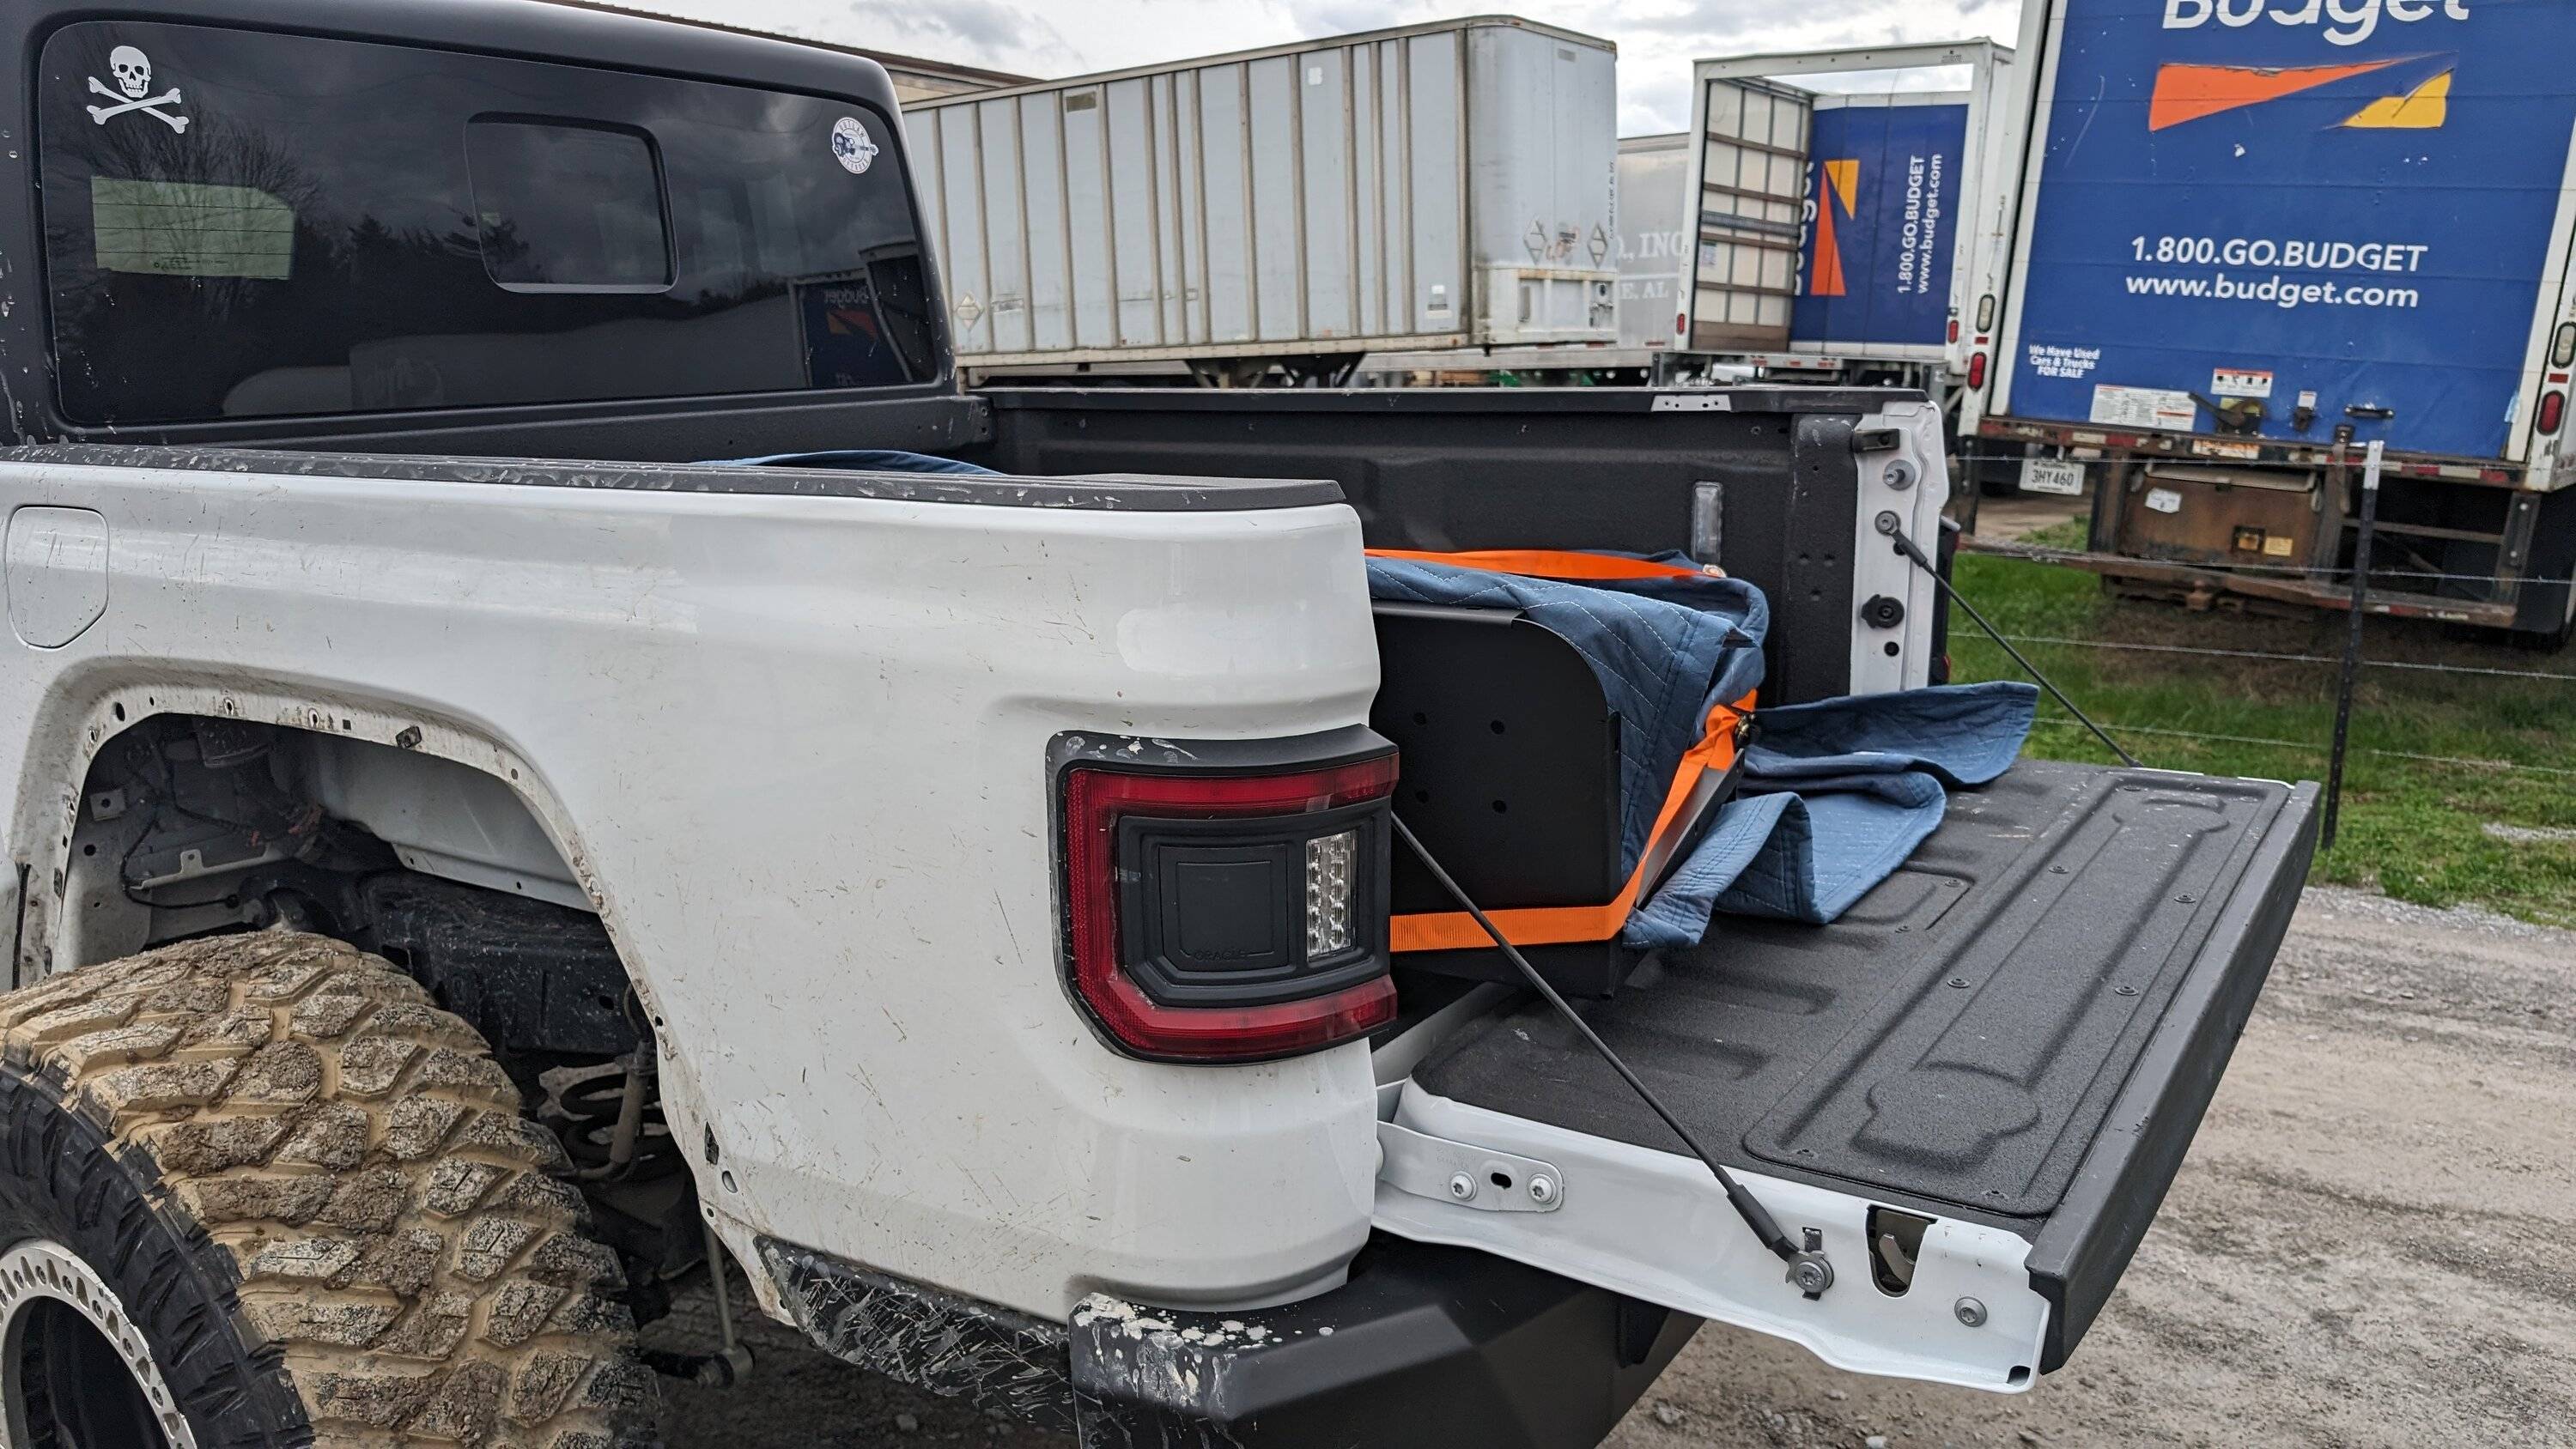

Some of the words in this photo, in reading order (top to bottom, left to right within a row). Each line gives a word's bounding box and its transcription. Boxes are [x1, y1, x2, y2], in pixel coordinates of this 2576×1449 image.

[1897, 155, 1925, 294] 1.800.GO.BUDGET
[1917, 153, 1943, 294] www.budget.com
[2131, 236, 2427, 272] 1.800.GO.BUDGET
[2125, 273, 2419, 308] www.budget.com
[2029, 344, 2046, 356] We
[2046, 346, 2073, 358] Have
[2074, 347, 2100, 360] Used
[2030, 355, 2053, 367] Cars
[2053, 357, 2061, 367] &
[2063, 358, 2095, 370] Trucks
[2037, 366, 2059, 376] FOR
[2059, 367, 2085, 379] SALE
